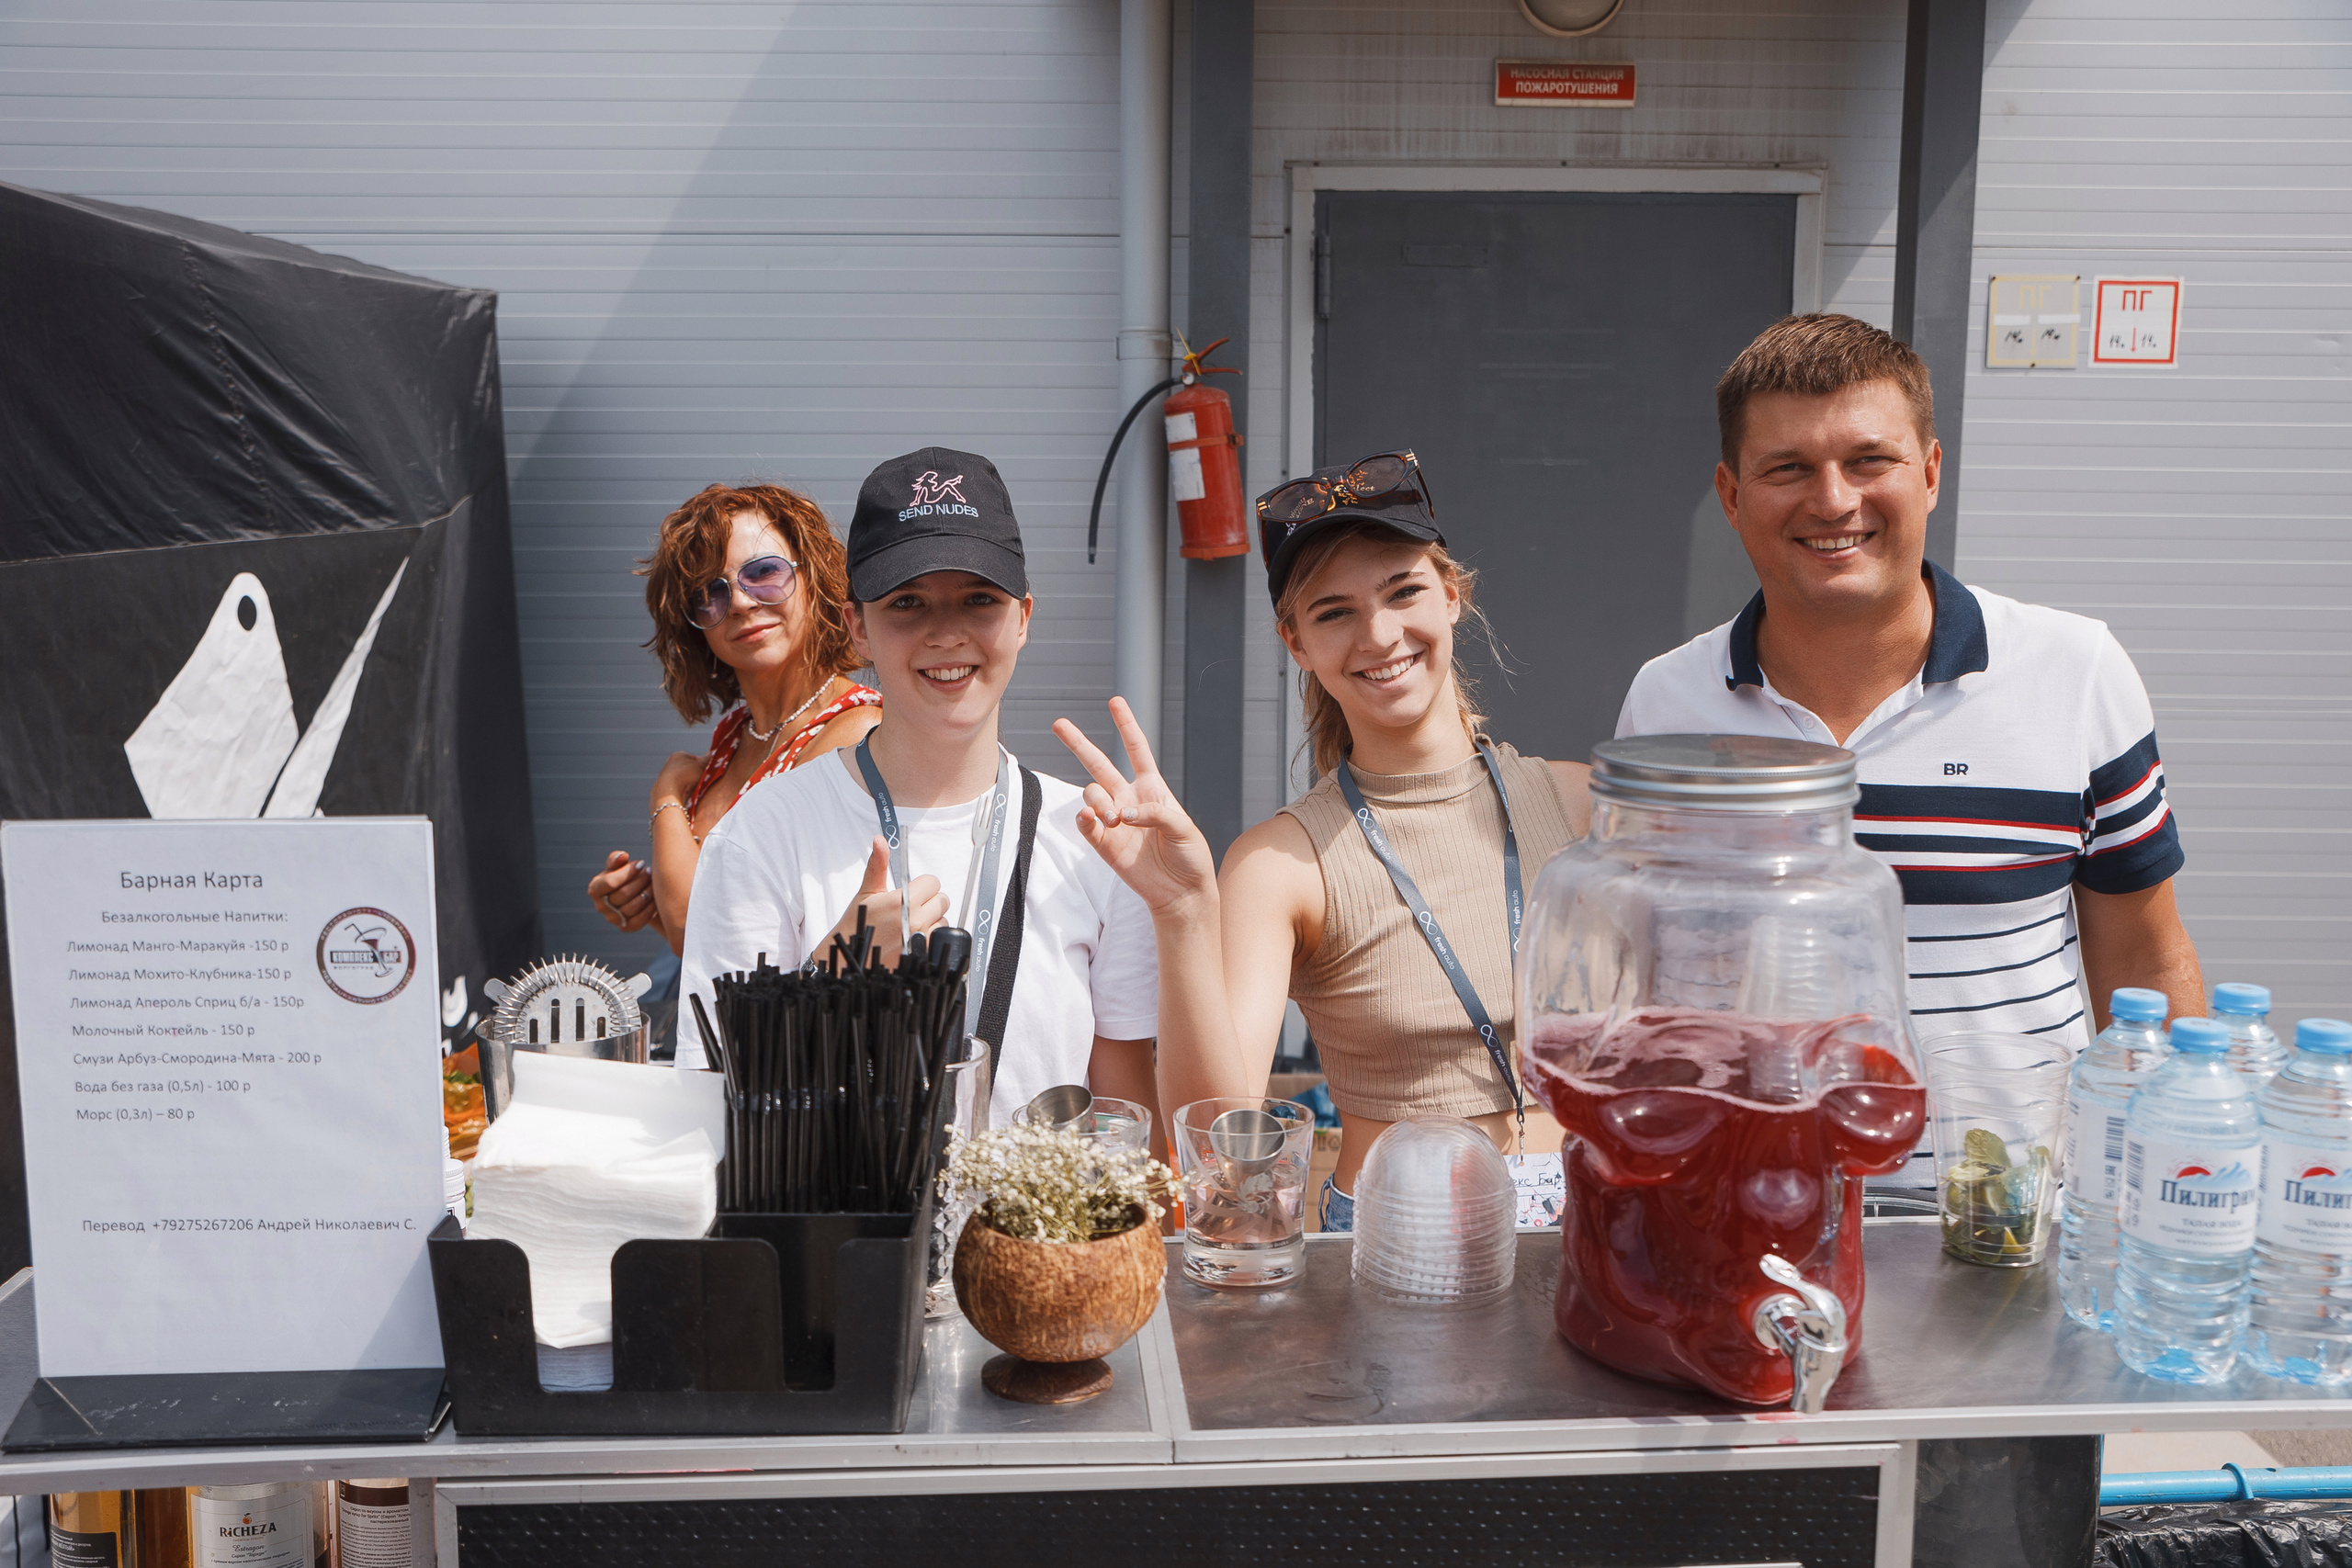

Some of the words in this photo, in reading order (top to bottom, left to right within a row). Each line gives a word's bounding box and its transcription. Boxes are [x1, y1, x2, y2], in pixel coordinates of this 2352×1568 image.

[1510, 68, 1570, 80] НАСОСНАЯ
[1572, 69, 1624, 83] СТАНЦИЯ
[1515, 81, 1619, 95] ПОЖАРОТУШЕНИЯ
[2122, 290, 2153, 311] ПГ
[899, 504, 933, 522] SEND
[936, 503, 979, 517] NUDES
[1943, 762, 1969, 776] BR
[878, 792, 887, 807] auto
[883, 804, 891, 823] fresh
[992, 819, 1001, 838] fresh
[1370, 829, 1384, 848] fresh
[1380, 844, 1392, 860] auto
[121, 873, 196, 892] Барная
[205, 872, 262, 891] Карта
[102, 912, 220, 922] Безалкогольные
[225, 911, 287, 921] Напитки:
[68, 942, 129, 953] Лимонад
[133, 941, 244, 953] Манго-Маракуйя
[251, 941, 277, 951] -150
[1433, 936, 1447, 956] fresh
[1444, 953, 1455, 970] auto
[69, 970, 130, 981] Лимонад
[135, 968, 279, 981] Мохито-Клубника-150
[71, 998, 131, 1009] Лимонад
[136, 998, 191, 1010] Апероль
[196, 997, 236, 1010] Сприц
[240, 997, 260, 1009] б/а
[274, 997, 303, 1009] 150р
[73, 1025, 142, 1036] Молочный
[149, 1025, 208, 1035] Коктейль
[221, 1024, 243, 1035] 150
[74, 1054, 113, 1066] Смузи
[119, 1053, 275, 1066] Арбуз-Смородина-Мята
[288, 1053, 310, 1063] 200
[1494, 1049, 1507, 1068] fresh
[1503, 1066, 1512, 1084] auto
[75, 1082, 107, 1094] Вода
[112, 1081, 133, 1091] без
[168, 1080, 203, 1093] (0,5л)
[218, 1080, 239, 1090] 100
[77, 1110, 111, 1122] Морс
[117, 1109, 152, 1122] (0,3л)
[168, 1109, 183, 1119] 80
[84, 1221, 145, 1234] Перевод
[153, 1219, 253, 1230] +79275267206
[258, 1219, 310, 1232] Андрей
[316, 1220, 399, 1230] Николаевич
[404, 1219, 416, 1230] С.
[232, 1544, 266, 1552] Estragon
